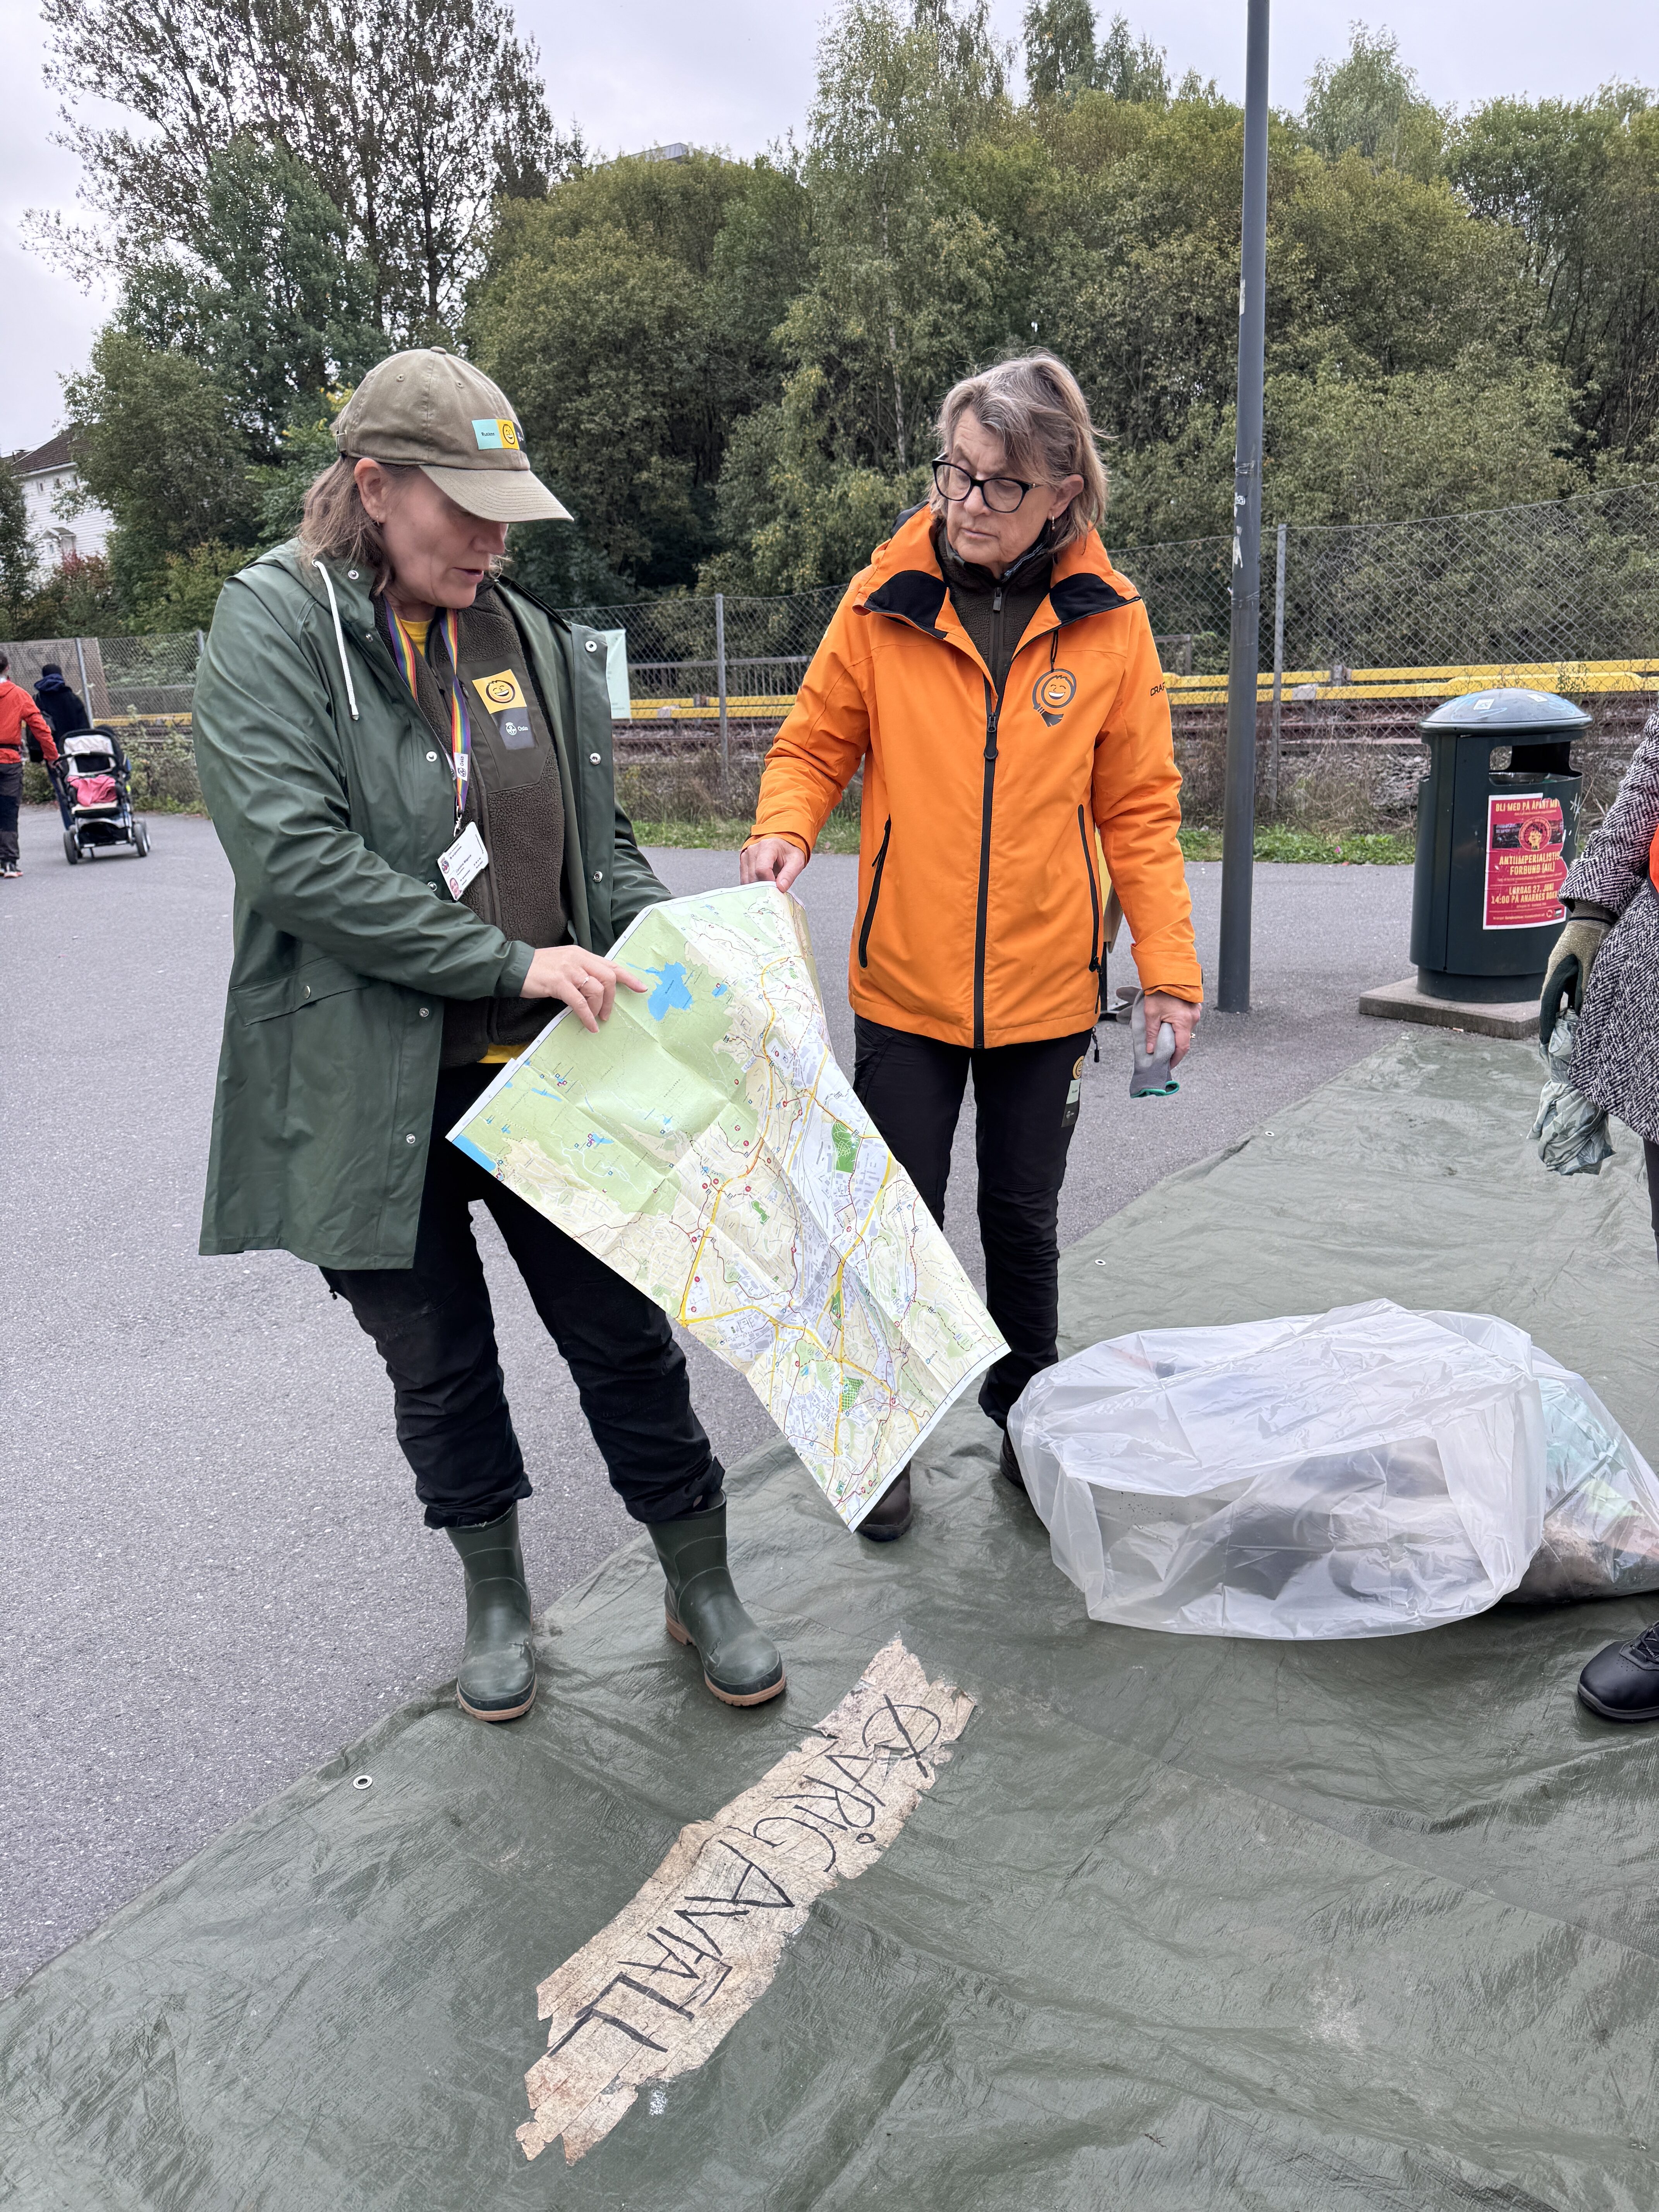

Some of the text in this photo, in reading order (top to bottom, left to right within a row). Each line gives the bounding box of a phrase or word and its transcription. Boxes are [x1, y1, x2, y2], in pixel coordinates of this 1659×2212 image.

[1496, 803, 1506, 812] BLI
[1507, 802, 1521, 811] MED
[1510, 864, 1540, 876] FORBUND
[1509, 886, 1531, 895] LØRDAG
[1542, 883, 1554, 892] JUNI
[1491, 895, 1510, 904] 14:00
[548, 1839, 794, 2057] AVFALL
